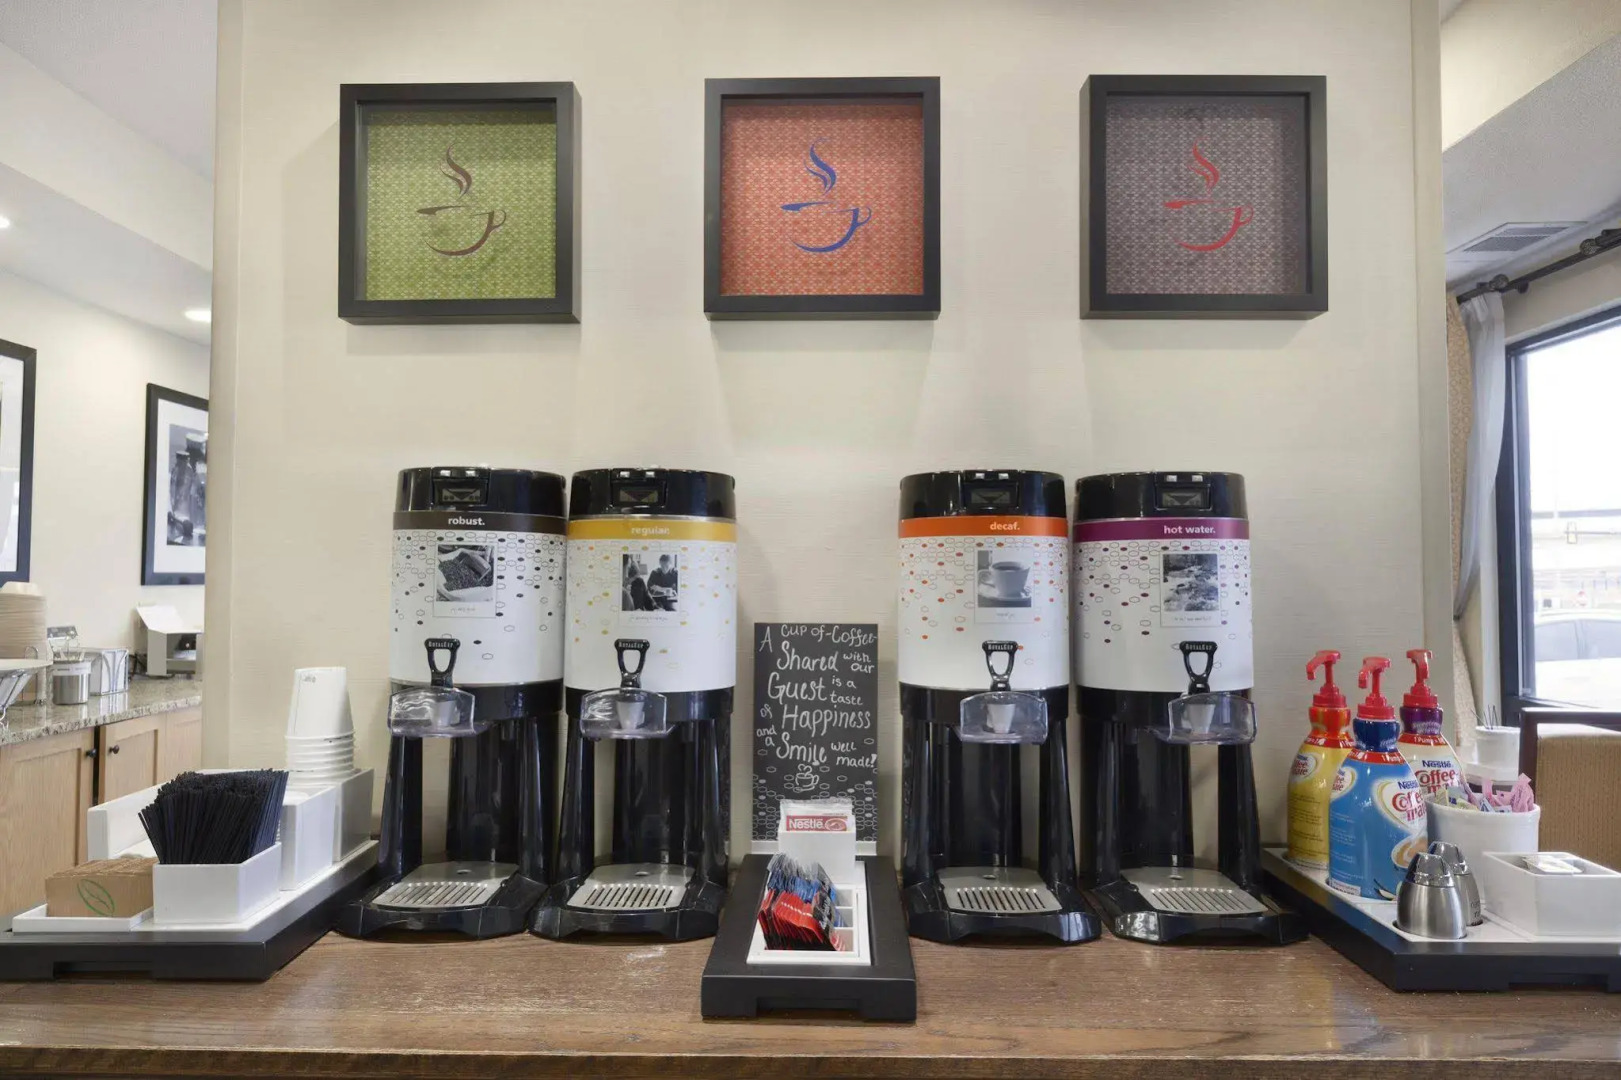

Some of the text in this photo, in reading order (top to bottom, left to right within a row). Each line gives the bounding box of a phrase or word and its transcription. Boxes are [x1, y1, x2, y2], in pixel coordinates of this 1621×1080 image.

[448, 516, 485, 526] robust.
[990, 522, 1020, 531] decaf.
[1163, 525, 1216, 534] hot water.
[759, 626, 773, 653] A
[776, 640, 871, 672] Shared with
[851, 663, 875, 674] our
[768, 671, 857, 705] Guest is a
[830, 690, 863, 705] taste
[760, 703, 871, 738] of Happiness
[756, 725, 777, 737] and
[765, 731, 857, 763] a Smile well
[836, 753, 878, 768] made!
